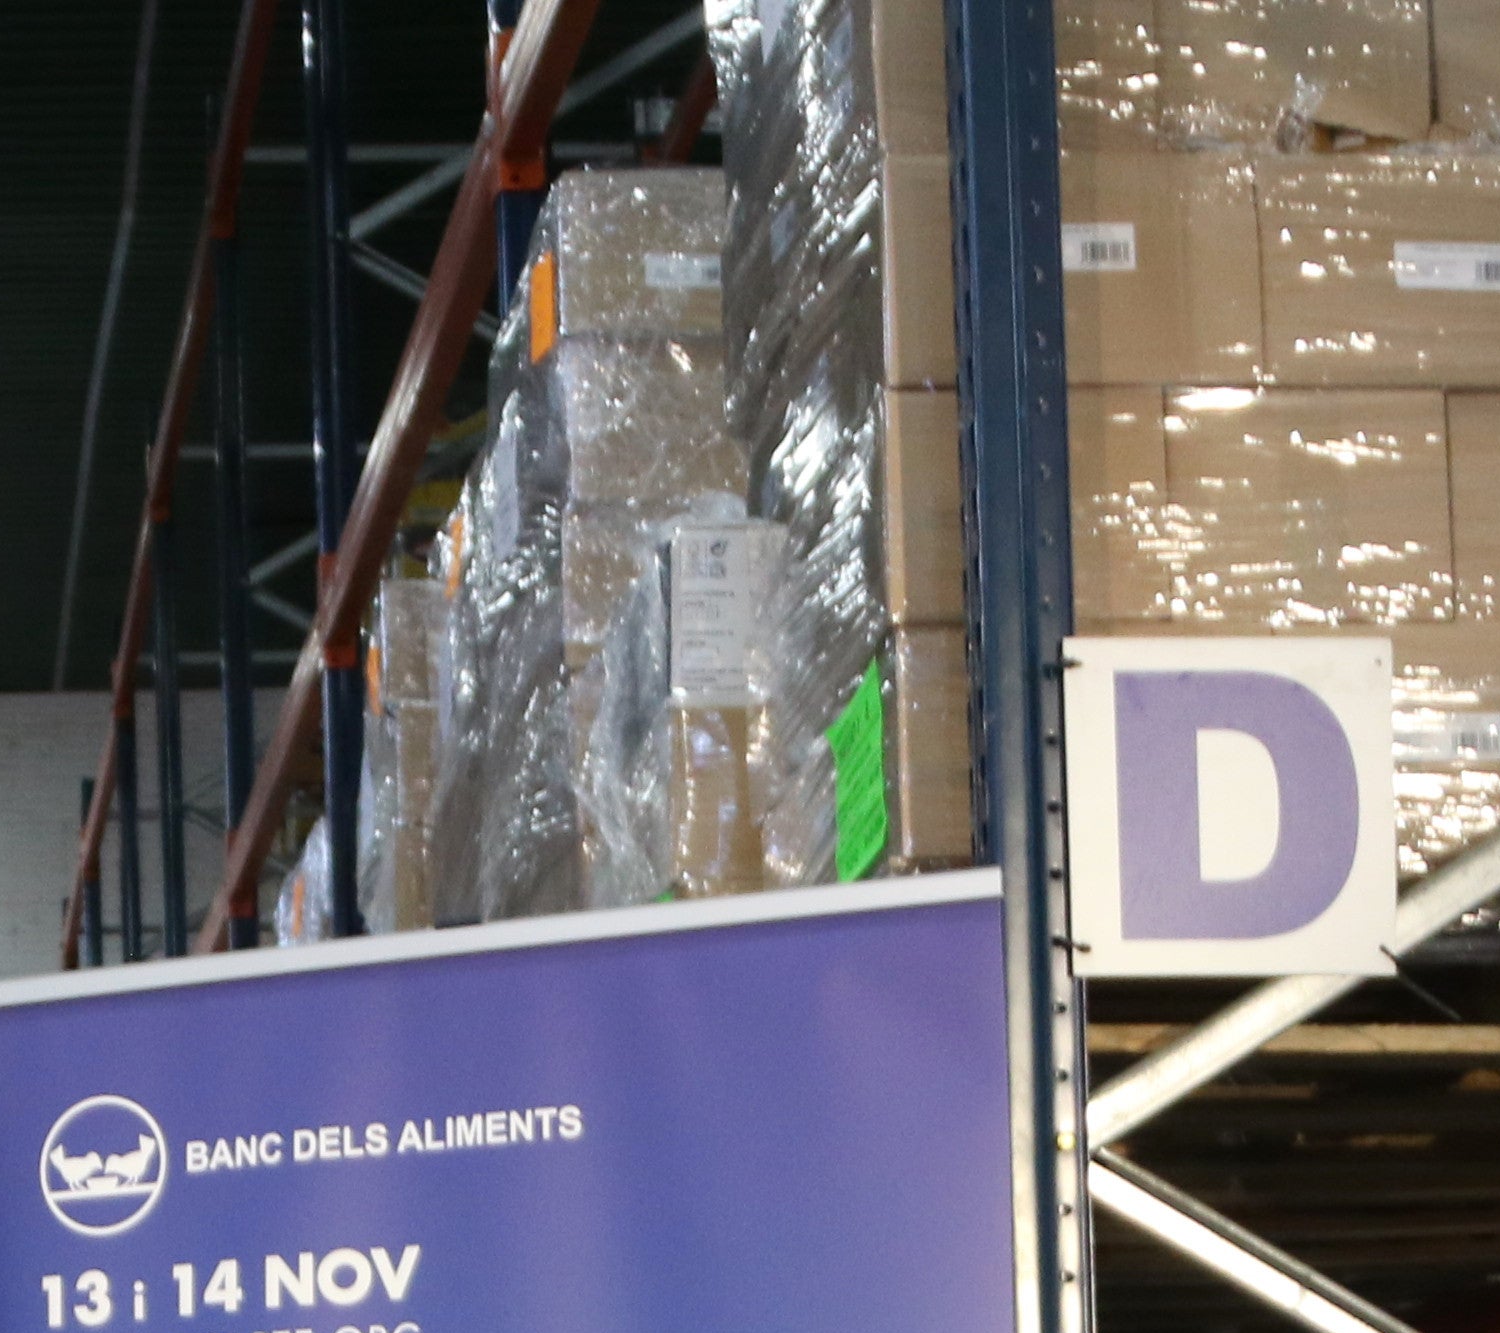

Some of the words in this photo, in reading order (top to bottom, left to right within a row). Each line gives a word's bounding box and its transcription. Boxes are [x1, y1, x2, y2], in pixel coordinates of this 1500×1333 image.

[1114, 670, 1360, 941] D
[186, 1132, 281, 1174] BANC
[293, 1122, 387, 1162] DELS
[398, 1104, 583, 1154] ALIMENTS
[42, 1269, 112, 1328] 13
[132, 1280, 147, 1321] i
[172, 1258, 242, 1317] 14
[265, 1244, 420, 1310] NOV
